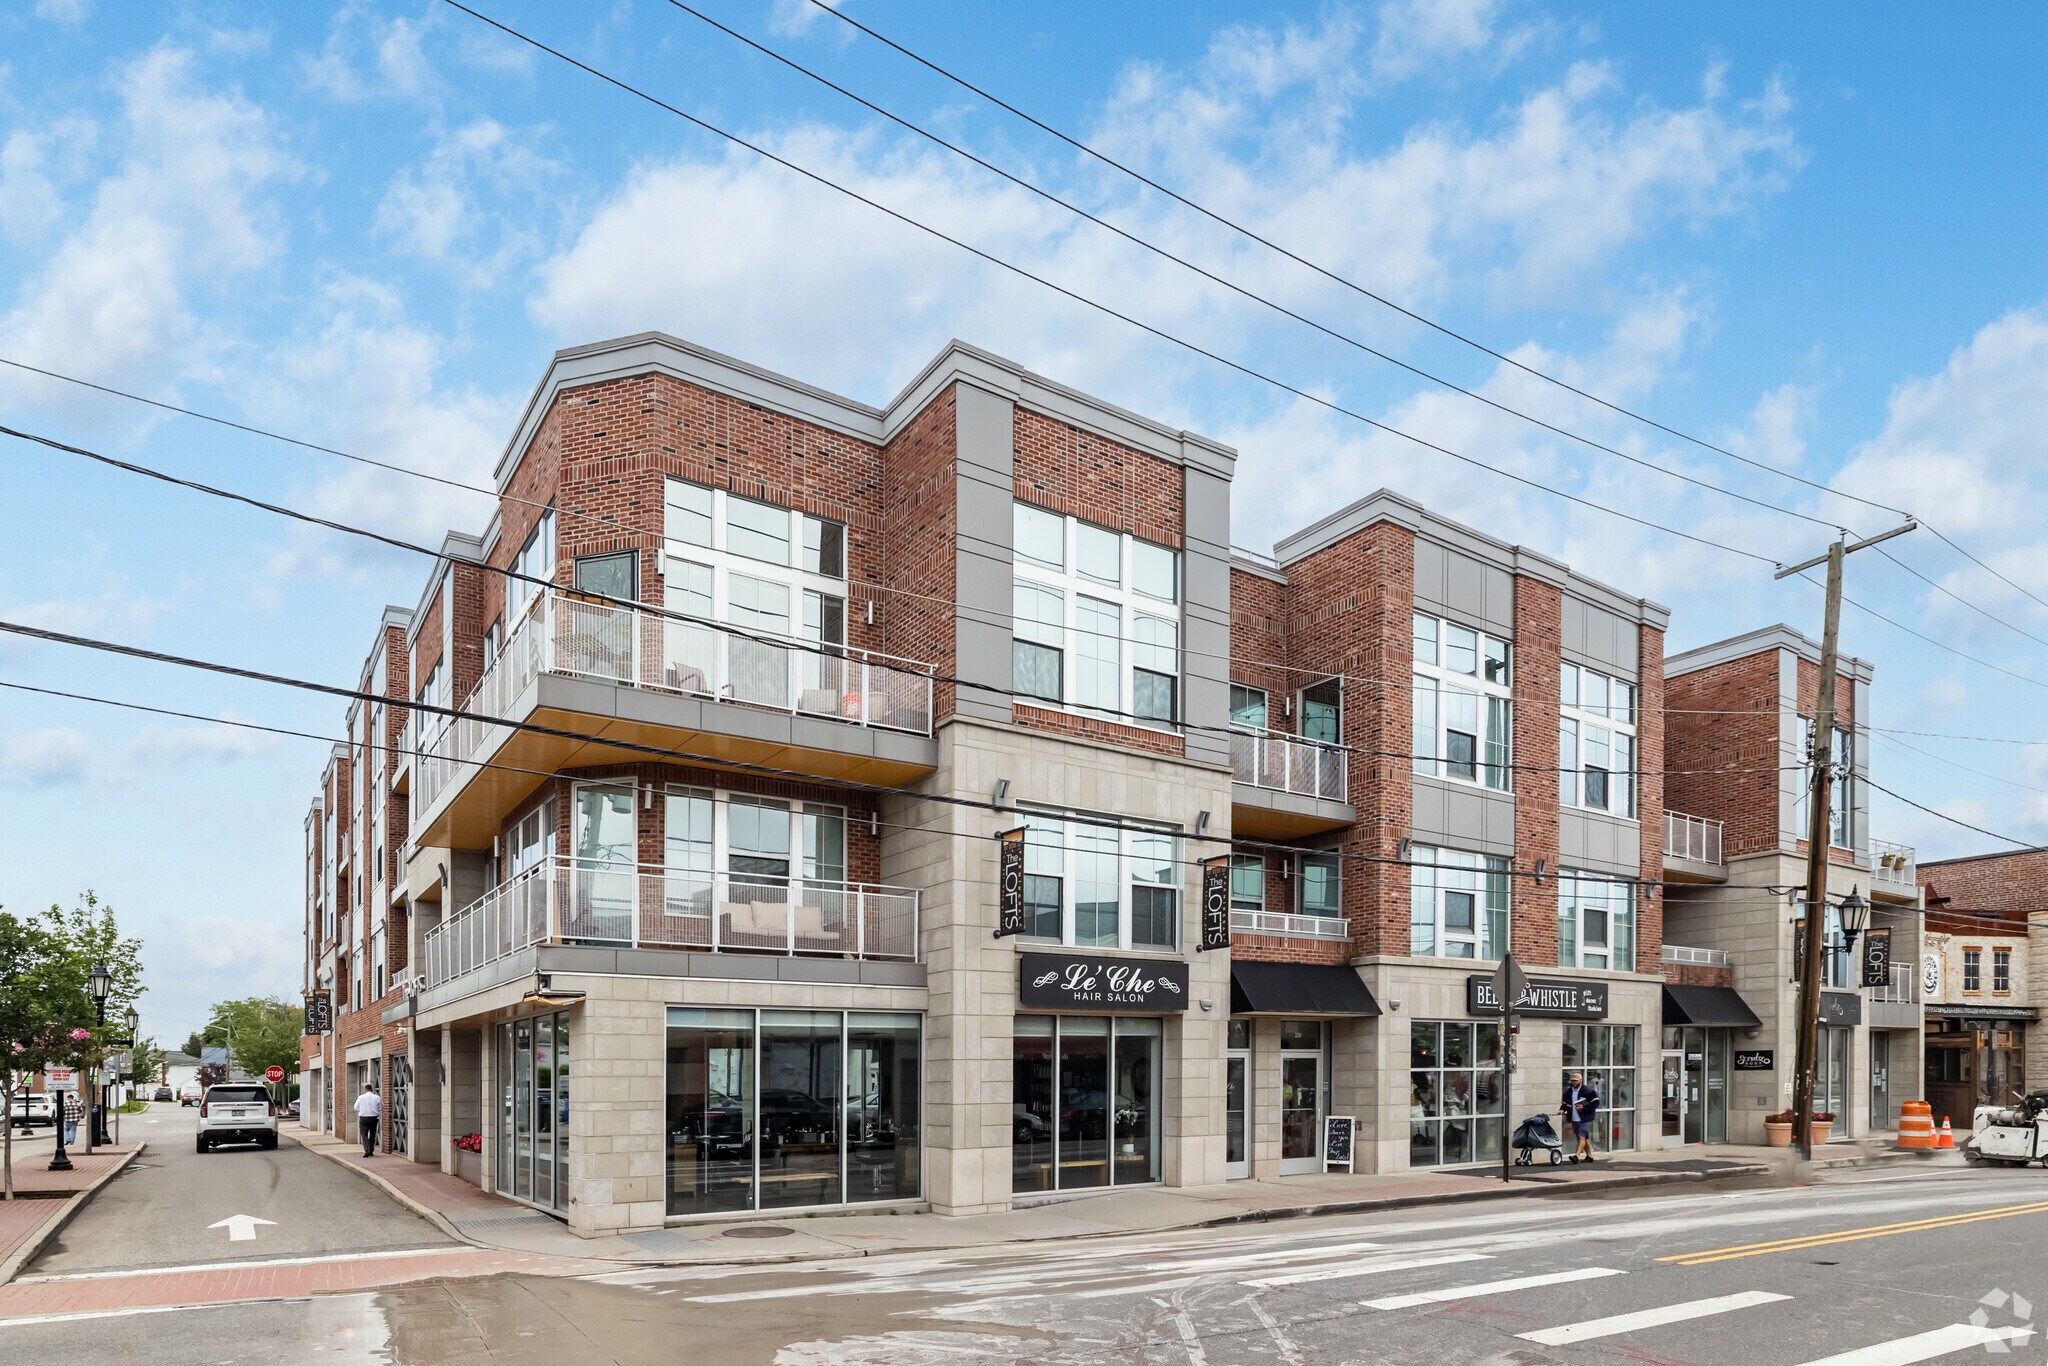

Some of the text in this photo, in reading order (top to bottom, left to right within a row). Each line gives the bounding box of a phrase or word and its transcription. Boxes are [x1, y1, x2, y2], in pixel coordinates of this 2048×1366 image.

[1006, 853, 1019, 863] The
[1005, 862, 1019, 930] LOFTS
[1210, 878, 1223, 887] The
[1208, 886, 1223, 945] LOFTS
[1106, 965, 1156, 993] Che
[1868, 947, 1884, 984] LOFTS
[1073, 991, 1144, 1003] HAIR SALON
[1529, 988, 1577, 1008] WHISTLE
[317, 1001, 328, 1029] LOFTS
